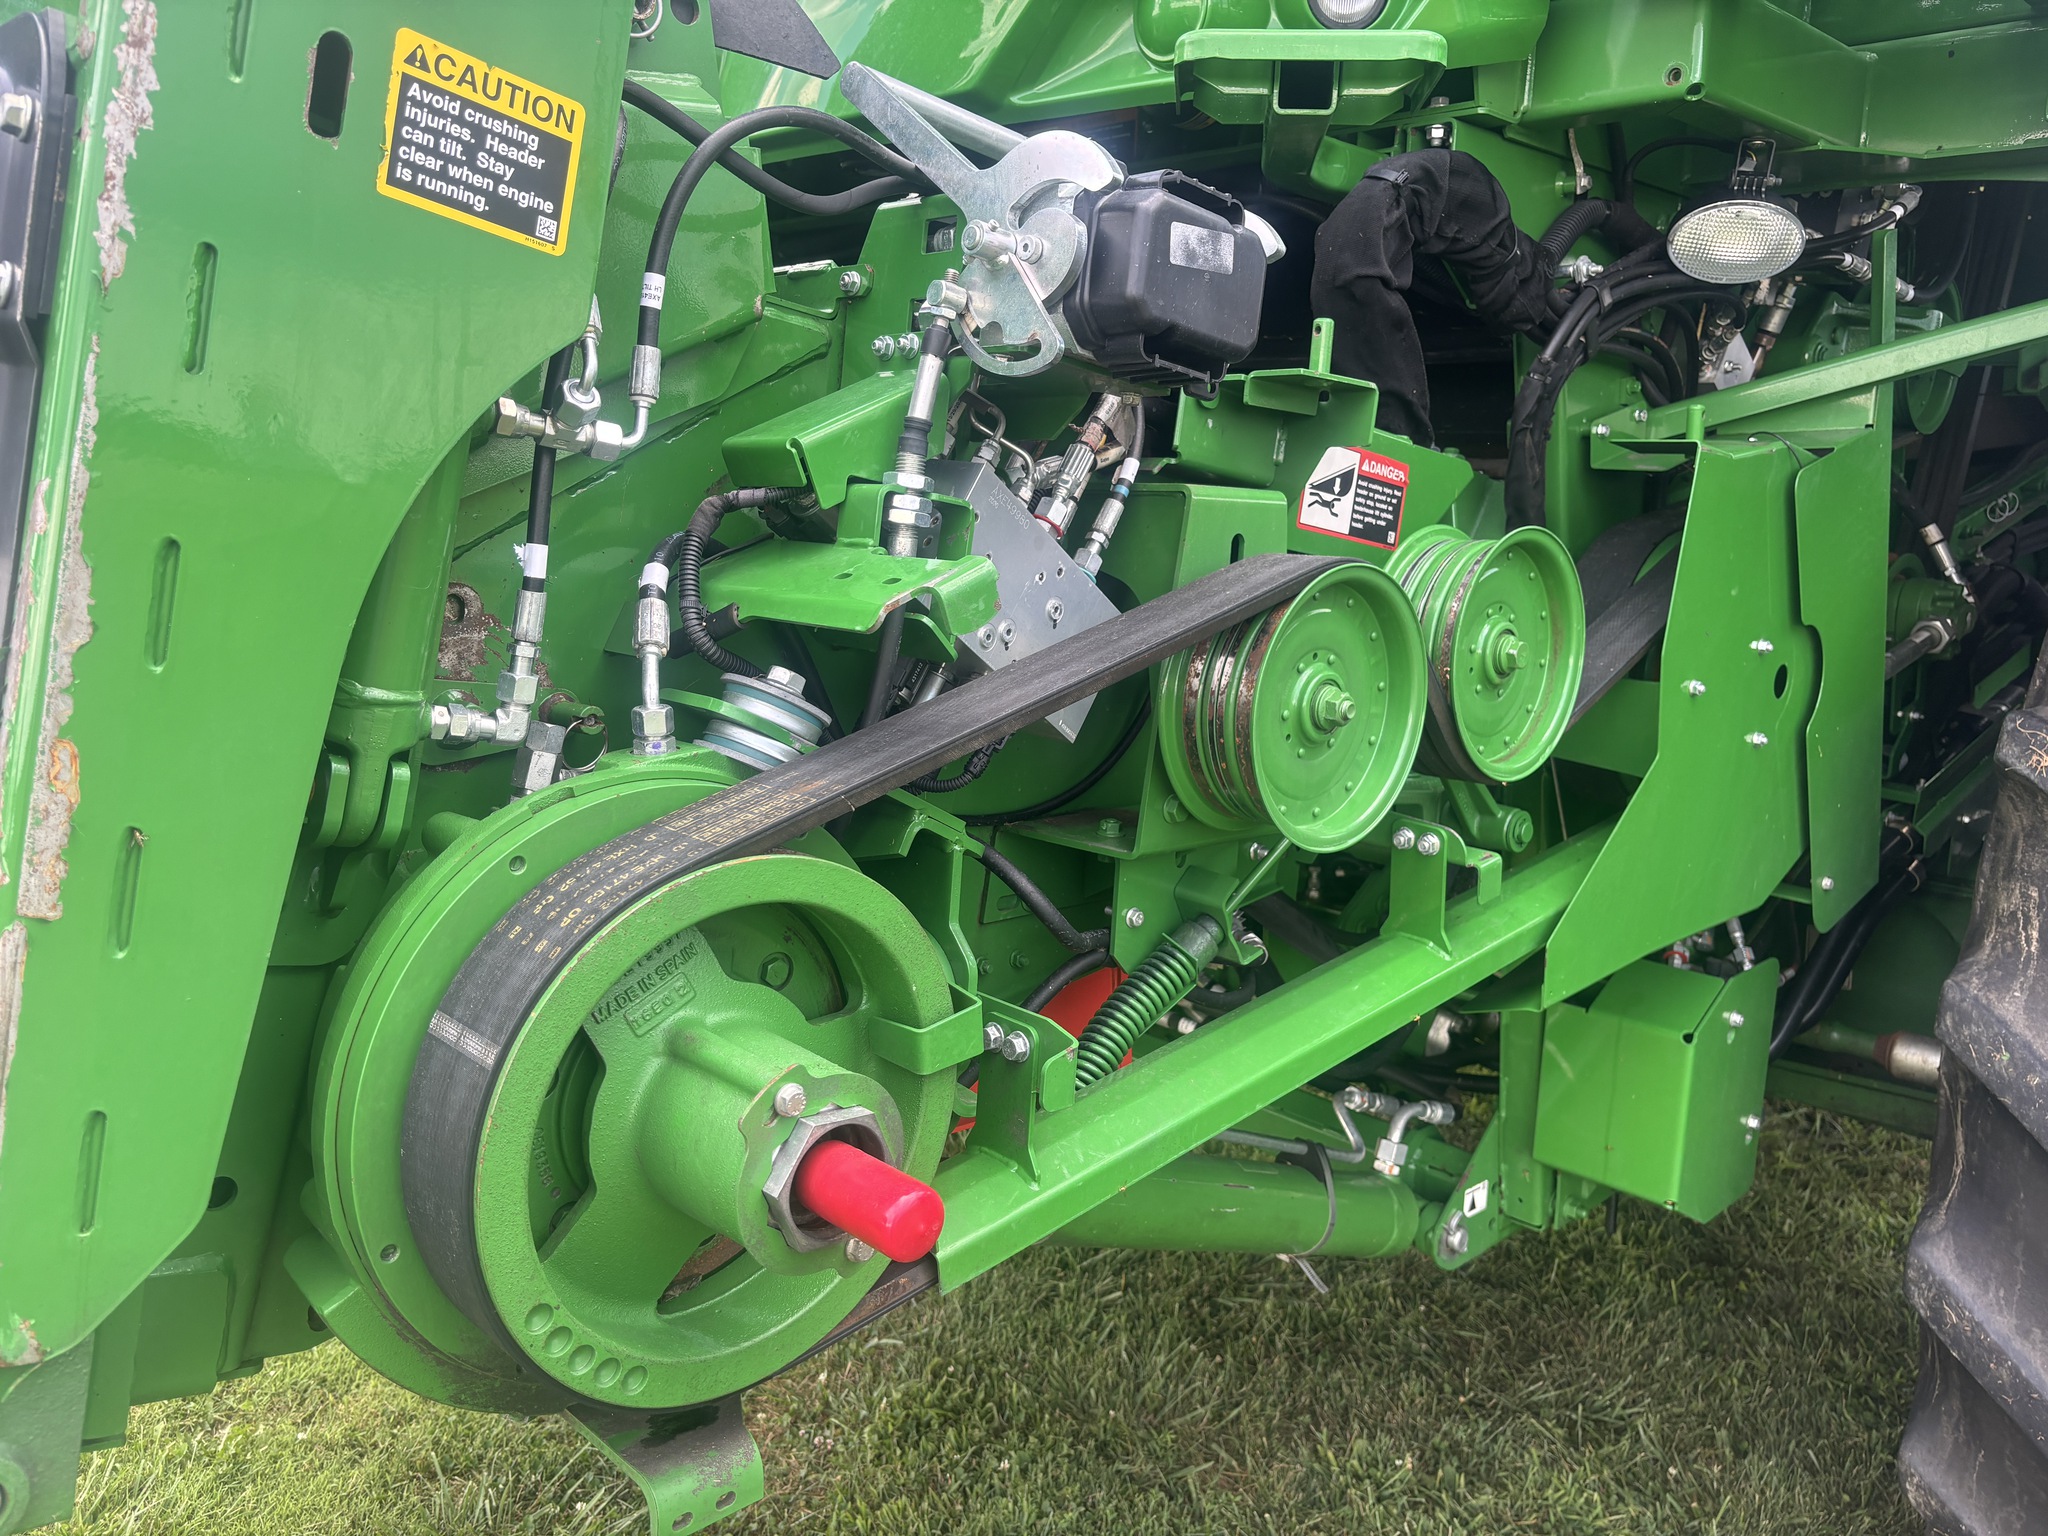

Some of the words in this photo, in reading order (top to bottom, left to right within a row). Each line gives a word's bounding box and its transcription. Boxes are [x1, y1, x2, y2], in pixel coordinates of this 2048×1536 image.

[407, 82, 460, 116] Avoid
[464, 107, 540, 151] crushing
[434, 54, 576, 134] CAUTION
[401, 125, 435, 149] can
[439, 136, 467, 161] tilt.
[476, 151, 515, 181] Stay
[404, 101, 476, 144] injuries.
[485, 133, 546, 170] Header
[395, 162, 412, 182] is
[416, 171, 490, 212] running.
[398, 145, 444, 172] clear
[448, 162, 494, 192] when
[498, 184, 554, 215] engine
[1370, 461, 1405, 483] DANGER
[592, 985, 640, 1025] MADE
[637, 973, 656, 994] IN
[655, 942, 698, 981] SPAIN
